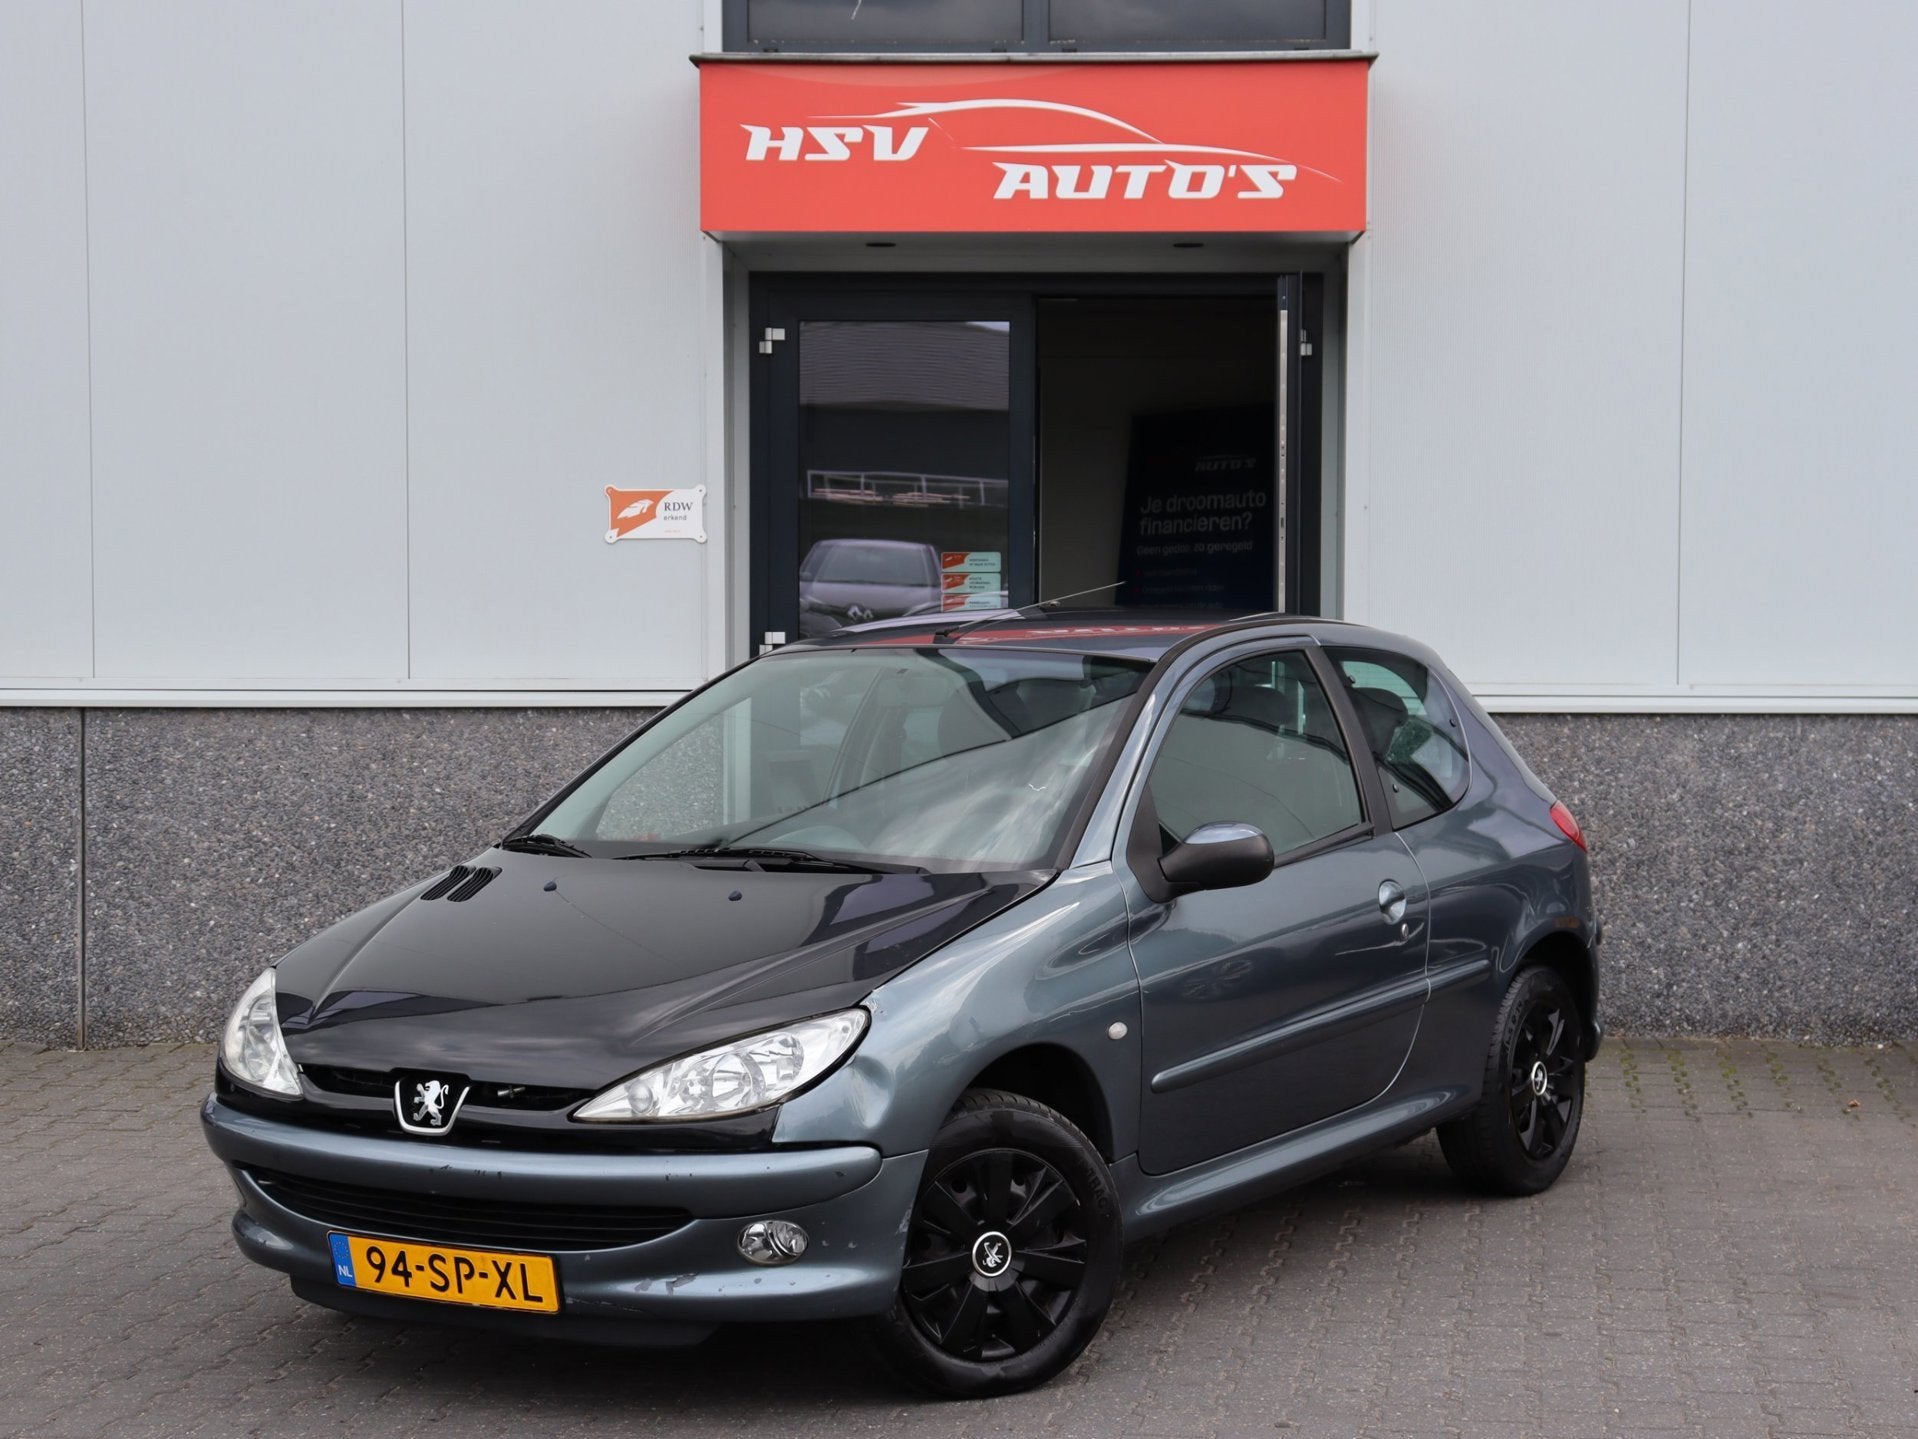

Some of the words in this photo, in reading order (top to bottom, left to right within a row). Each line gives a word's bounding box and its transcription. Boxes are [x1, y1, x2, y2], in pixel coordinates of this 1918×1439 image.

[740, 124, 929, 161] HSV
[992, 160, 1298, 199] AUTO'S
[664, 502, 693, 511] RDW
[1140, 497, 1163, 514] Je
[1166, 489, 1267, 513] droomauto
[1139, 511, 1253, 536] financieren?
[338, 1264, 353, 1278] NL
[365, 1245, 543, 1303] 94-SP-XL
